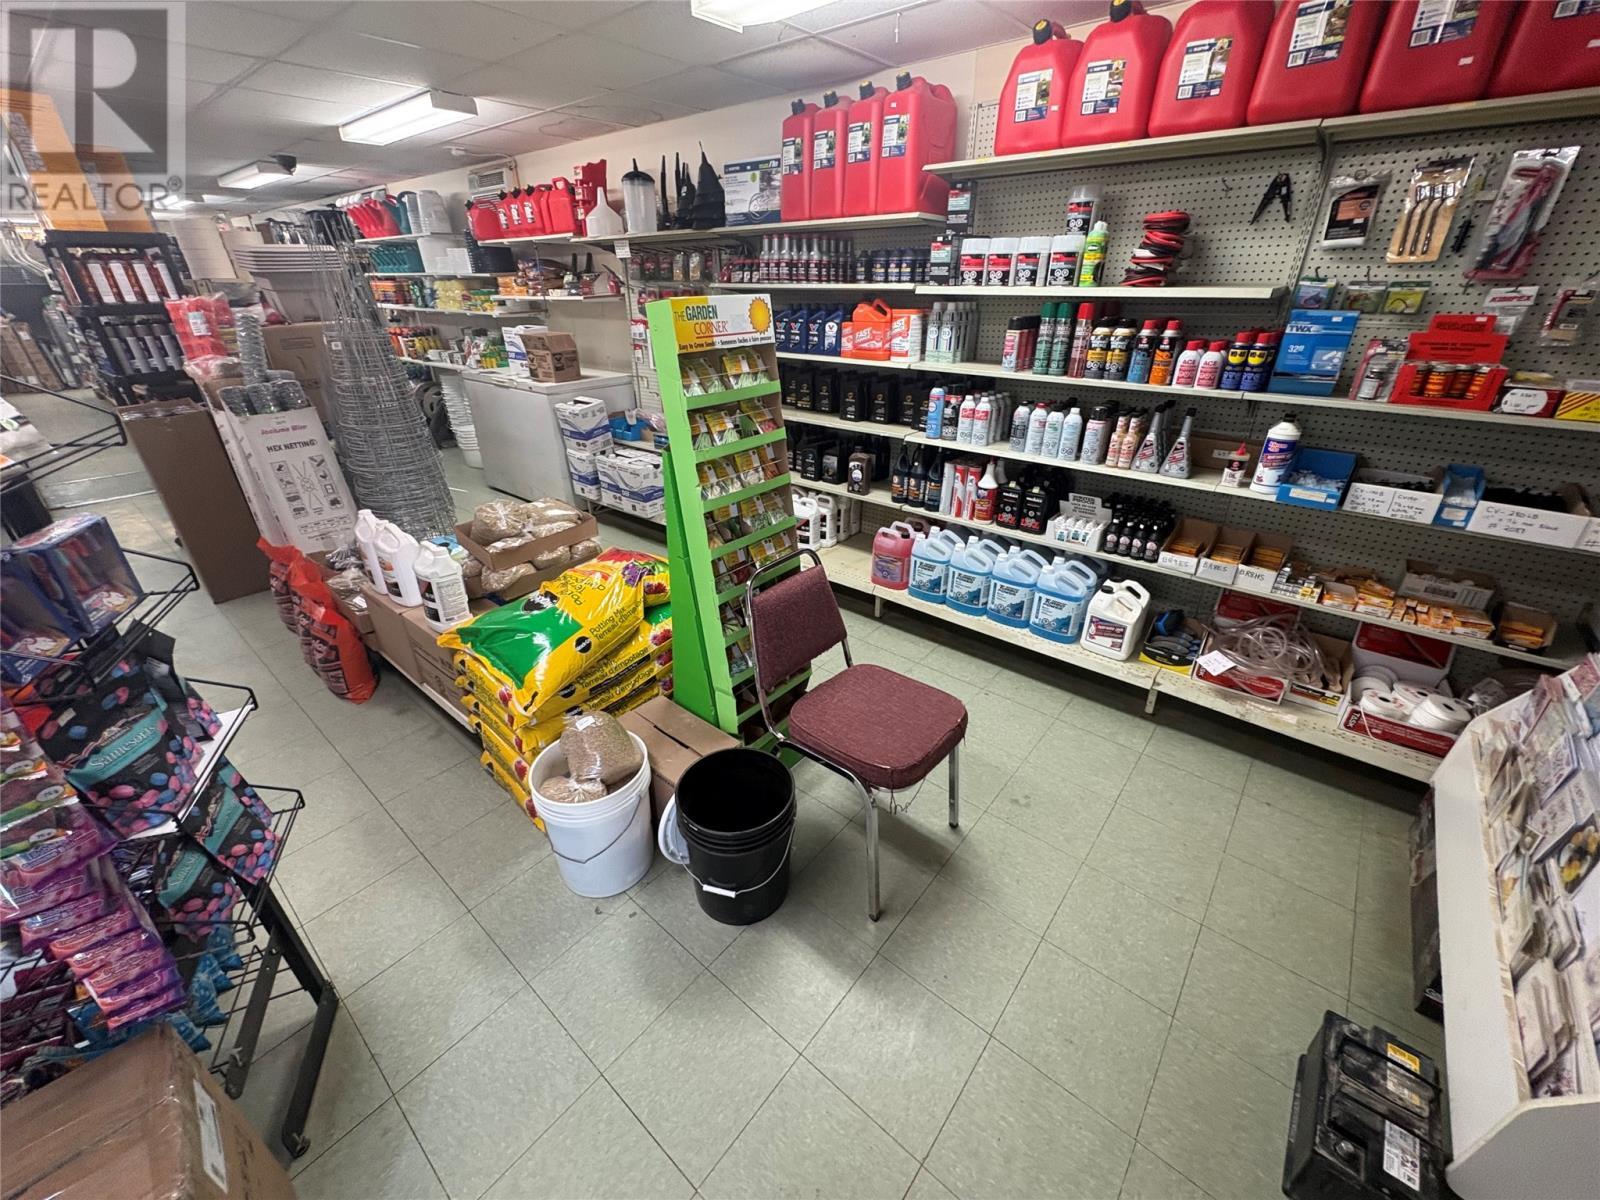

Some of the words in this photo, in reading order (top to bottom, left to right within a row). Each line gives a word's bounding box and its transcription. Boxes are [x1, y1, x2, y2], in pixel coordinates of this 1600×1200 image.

[674, 311, 687, 322] THE
[685, 305, 718, 321] GARDEN
[1289, 325, 1312, 333] TWX
[694, 341, 705, 349] Grow
[266, 444, 282, 453] HEX
[284, 439, 316, 450] NETTING
[590, 616, 615, 634] Potting
[613, 606, 625, 618] Mix
[595, 621, 619, 641] Terreau
[583, 672, 608, 688] Terreau
[608, 647, 648, 675] d'empotage
[1347, 713, 1360, 728] TASK
